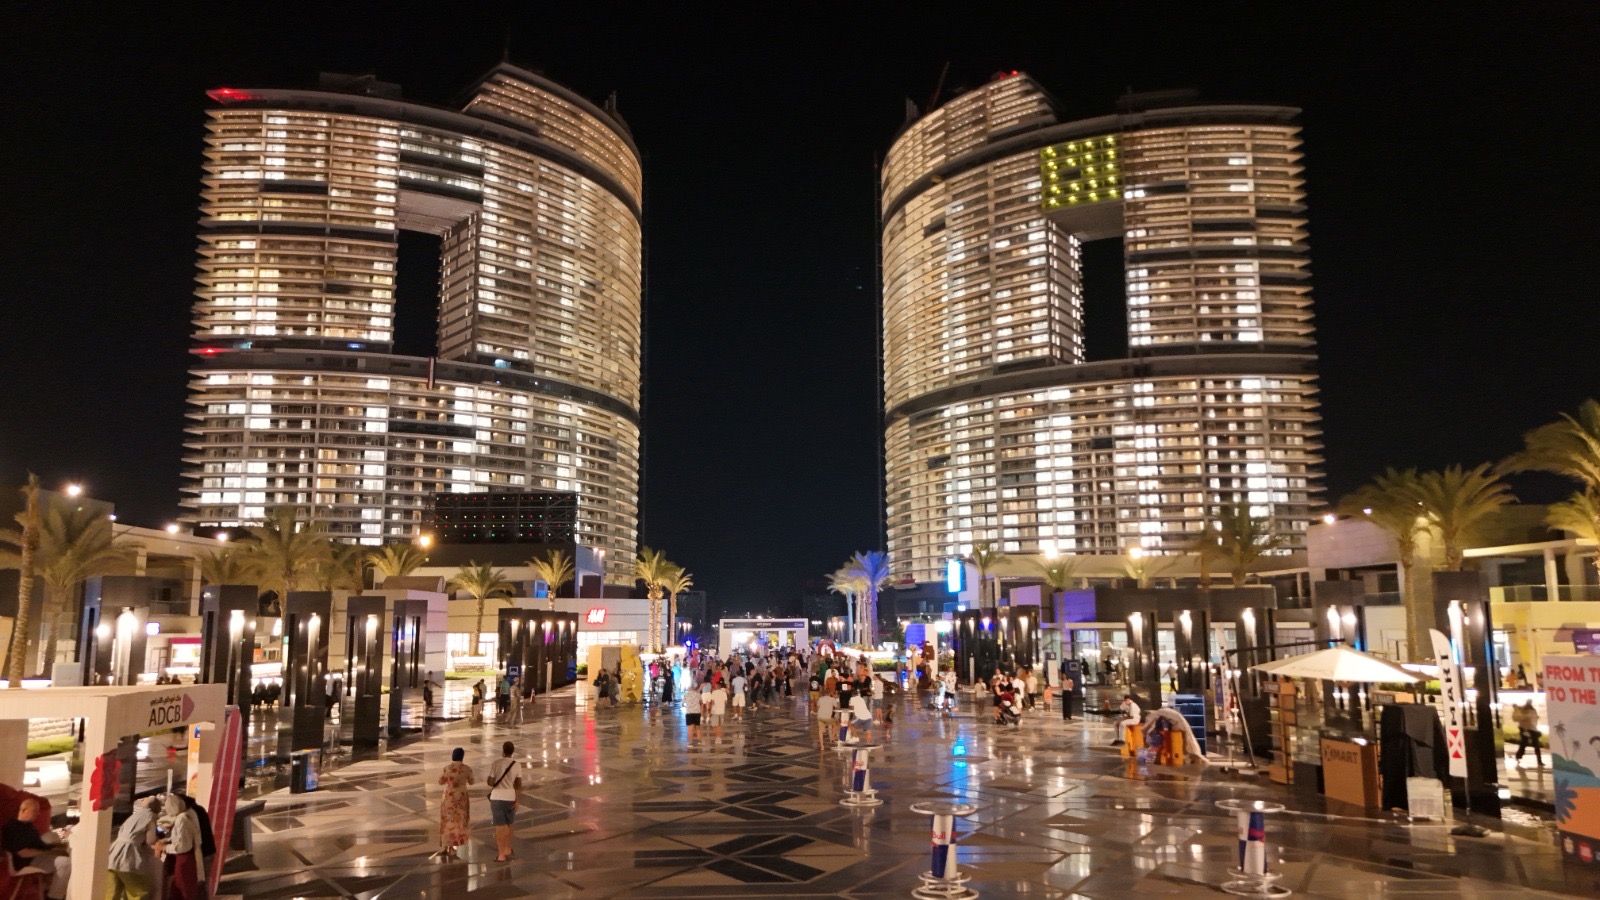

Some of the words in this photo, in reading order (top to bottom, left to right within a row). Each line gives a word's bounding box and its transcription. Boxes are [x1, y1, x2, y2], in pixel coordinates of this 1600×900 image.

[1545, 665, 1585, 681] FROM
[1548, 686, 1566, 702] TO
[1569, 688, 1597, 705] THE
[148, 705, 181, 727] ADCB
